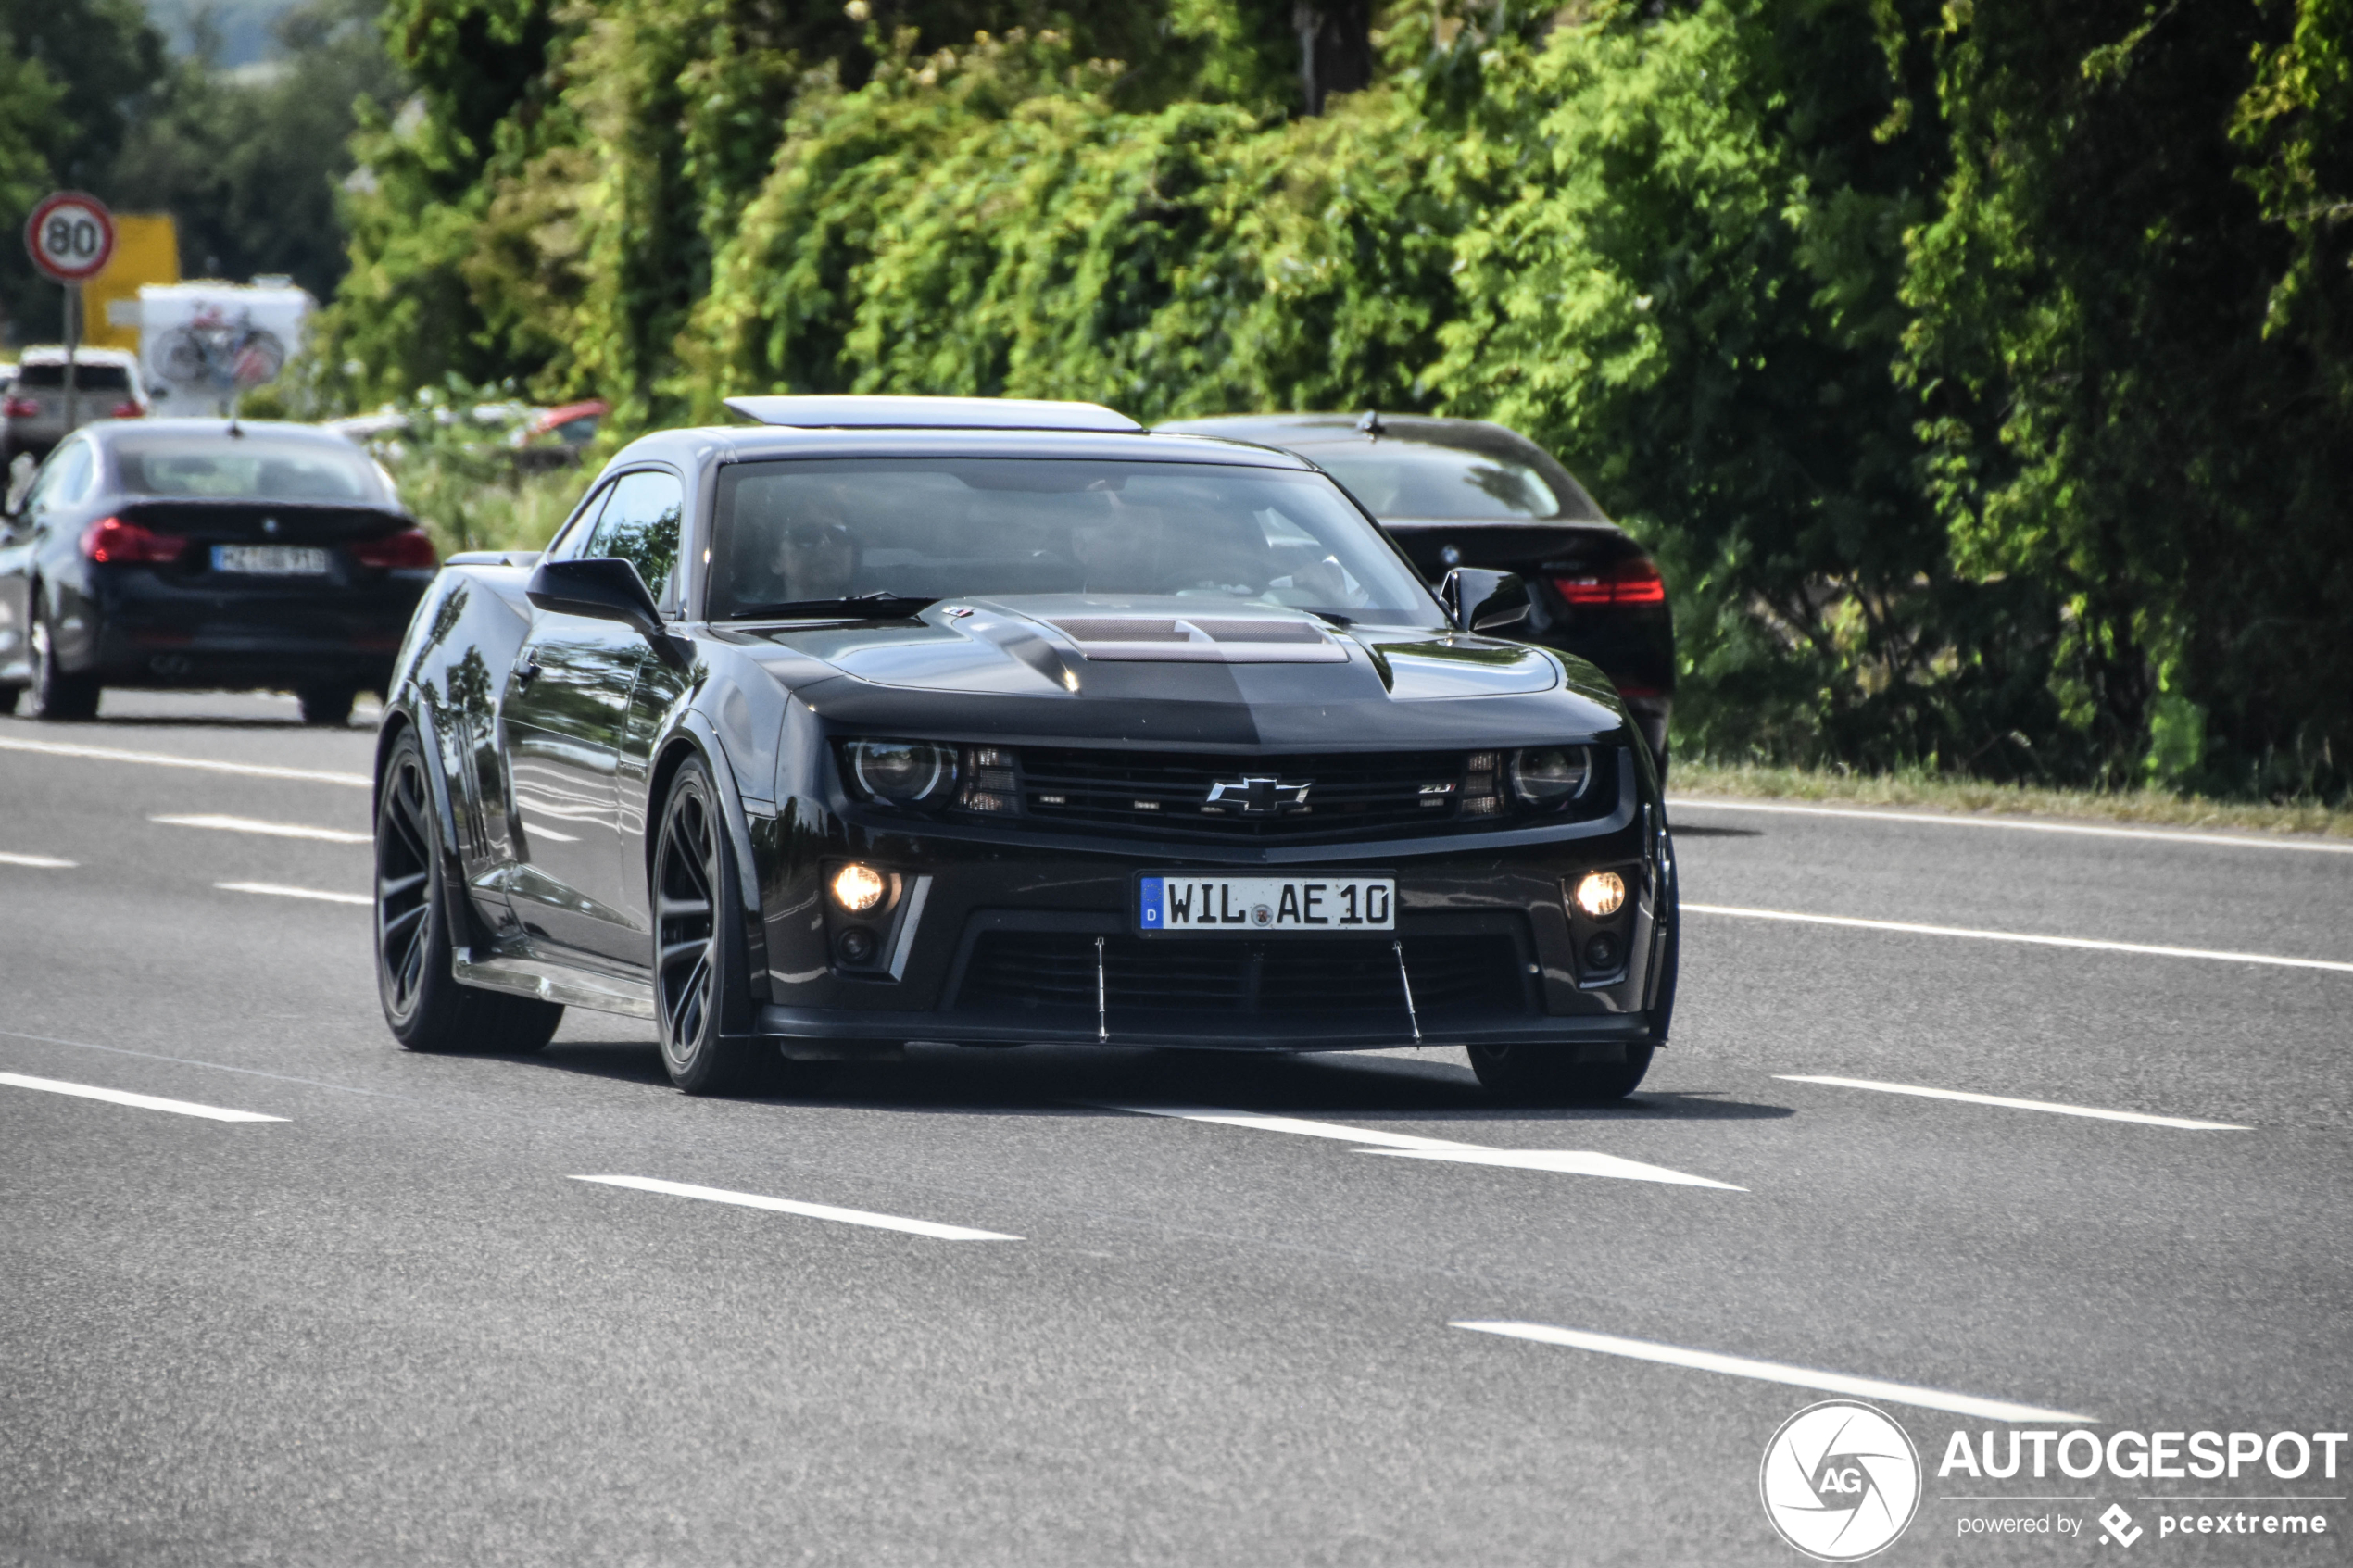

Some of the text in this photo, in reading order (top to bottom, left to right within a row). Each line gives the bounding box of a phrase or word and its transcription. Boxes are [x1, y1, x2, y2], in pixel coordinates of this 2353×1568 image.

[47, 216, 96, 258] 80
[1147, 909, 1157, 922] D
[1168, 884, 1390, 924] WIL AE 10
